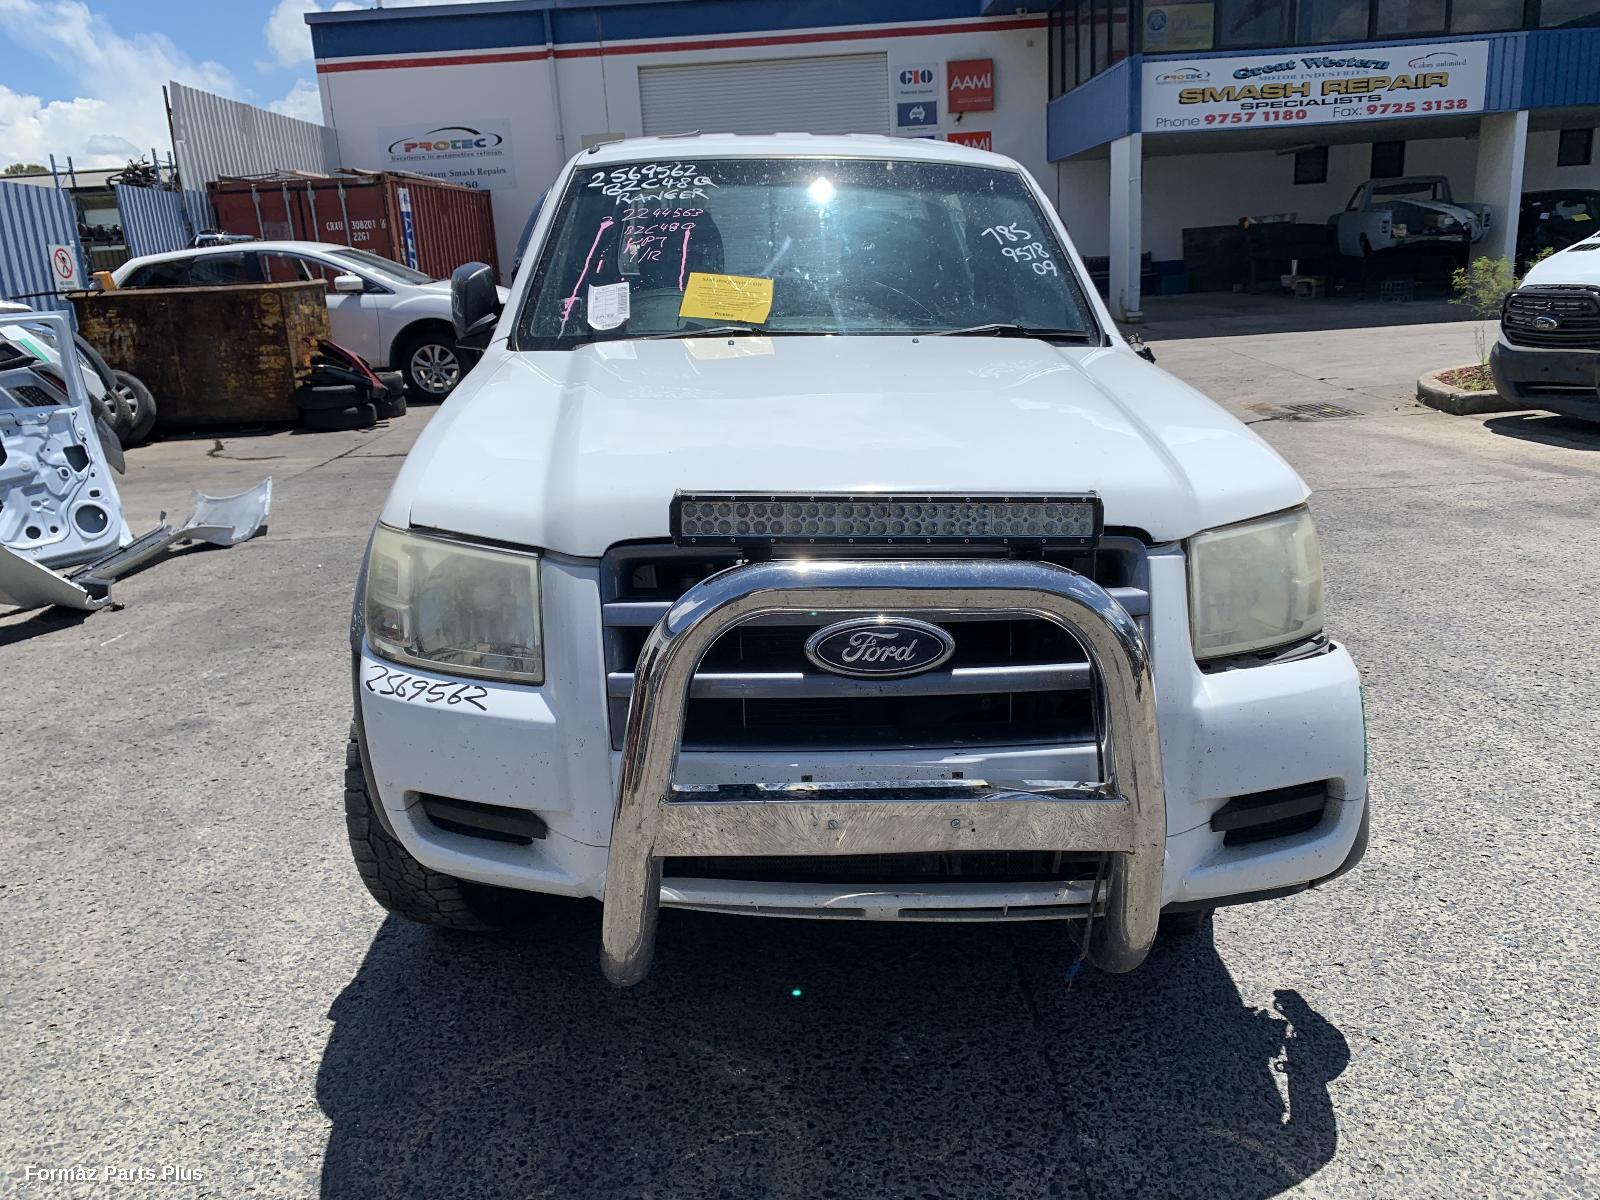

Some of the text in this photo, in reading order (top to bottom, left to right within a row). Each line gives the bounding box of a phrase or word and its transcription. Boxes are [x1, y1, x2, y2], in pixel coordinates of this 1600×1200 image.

[899, 69, 933, 85] GIO
[1162, 73, 1203, 81] PROTEC
[1233, 57, 1391, 80] Great Western
[1301, 70, 1369, 80] INDUSTRIES
[950, 73, 992, 91] AAMI
[1178, 71, 1450, 105] SMASH REPAIR
[1240, 94, 1383, 111] SPECIALISTS
[1332, 99, 1468, 118] Fax: 9725 3138
[1156, 109, 1308, 128] Phone 9757 1180
[404, 138, 487, 153] PROTEC
[449, 168, 475, 177] Smash
[477, 167, 507, 177] Repairs
[588, 164, 698, 188] 2569562
[615, 188, 710, 205] RANGER
[326, 220, 344, 232] CRXU
[351, 219, 376, 230] 308201
[981, 222, 1032, 245] 785
[352, 232, 370, 241] 22G1
[1002, 242, 1050, 263] 9578
[1032, 260, 1058, 277] 09
[841, 631, 919, 663] Ford
[366, 665, 488, 711] 2569562
